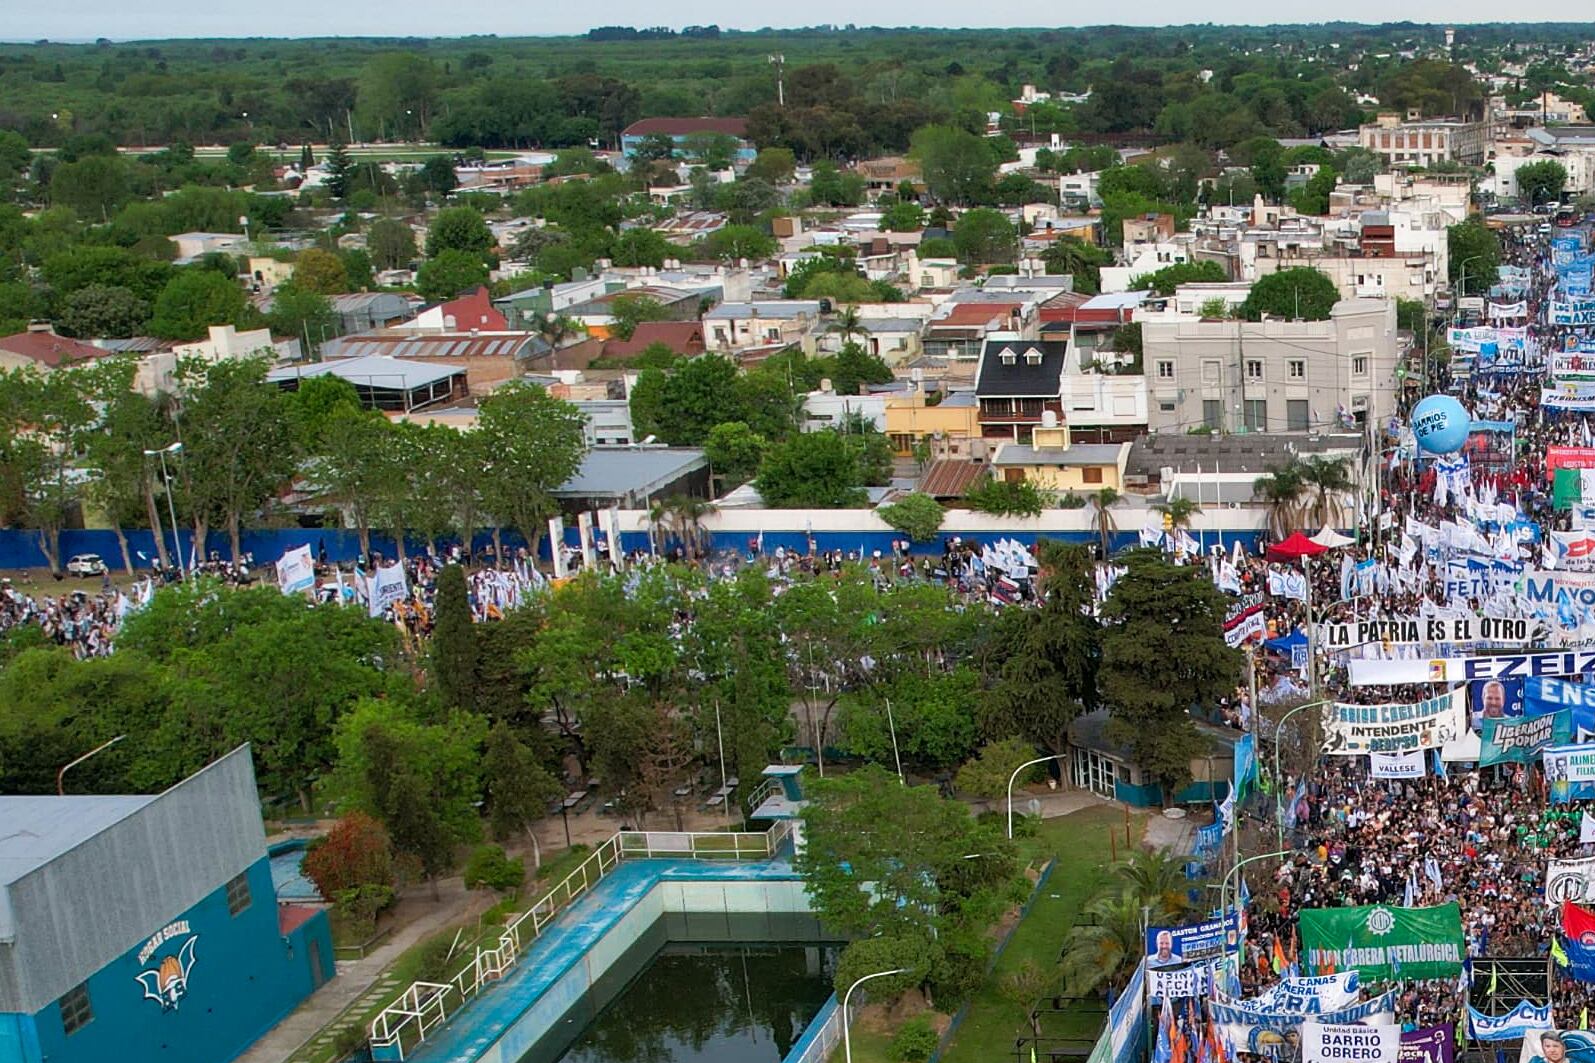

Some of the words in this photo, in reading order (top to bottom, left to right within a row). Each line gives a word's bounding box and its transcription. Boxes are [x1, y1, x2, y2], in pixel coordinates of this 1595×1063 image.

[1412, 412, 1447, 431] BARRIOS
[1419, 427, 1433, 438] DE
[1433, 423, 1445, 435] PIE
[1329, 625, 1349, 646] LA
[1358, 620, 1419, 642] PATRIA
[1427, 620, 1446, 641] ES
[1455, 619, 1472, 640] EL
[1481, 618, 1526, 640] OTRO
[1351, 720, 1436, 737] INTENDENTE
[1502, 728, 1552, 752] POPULAR
[1298, 975, 1337, 986] CANAS
[1322, 1034, 1381, 1046] BARRIO
[1321, 1047, 1382, 1059] OBRERO
